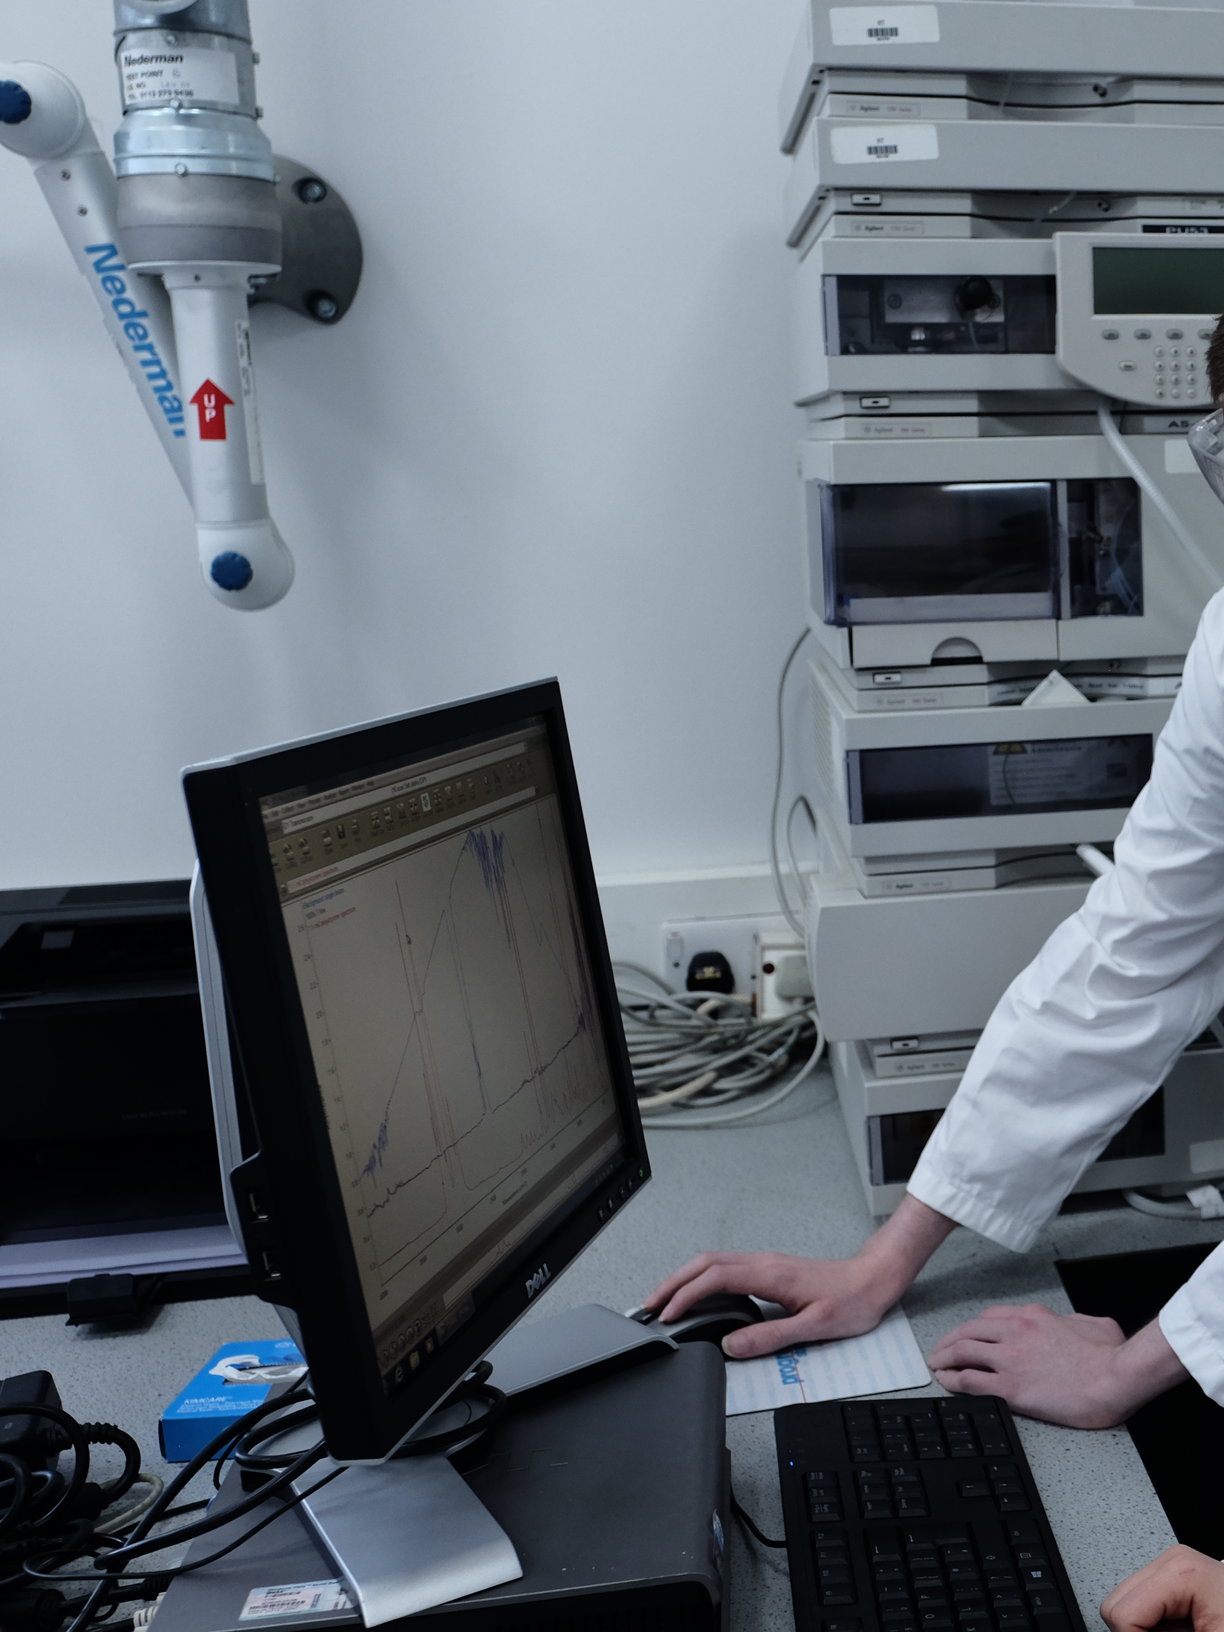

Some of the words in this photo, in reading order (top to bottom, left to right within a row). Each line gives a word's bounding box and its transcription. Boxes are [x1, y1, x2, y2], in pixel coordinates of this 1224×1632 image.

[124, 54, 184, 66] Nederman
[203, 393, 217, 422] UP
[525, 1263, 551, 1298] DELL
